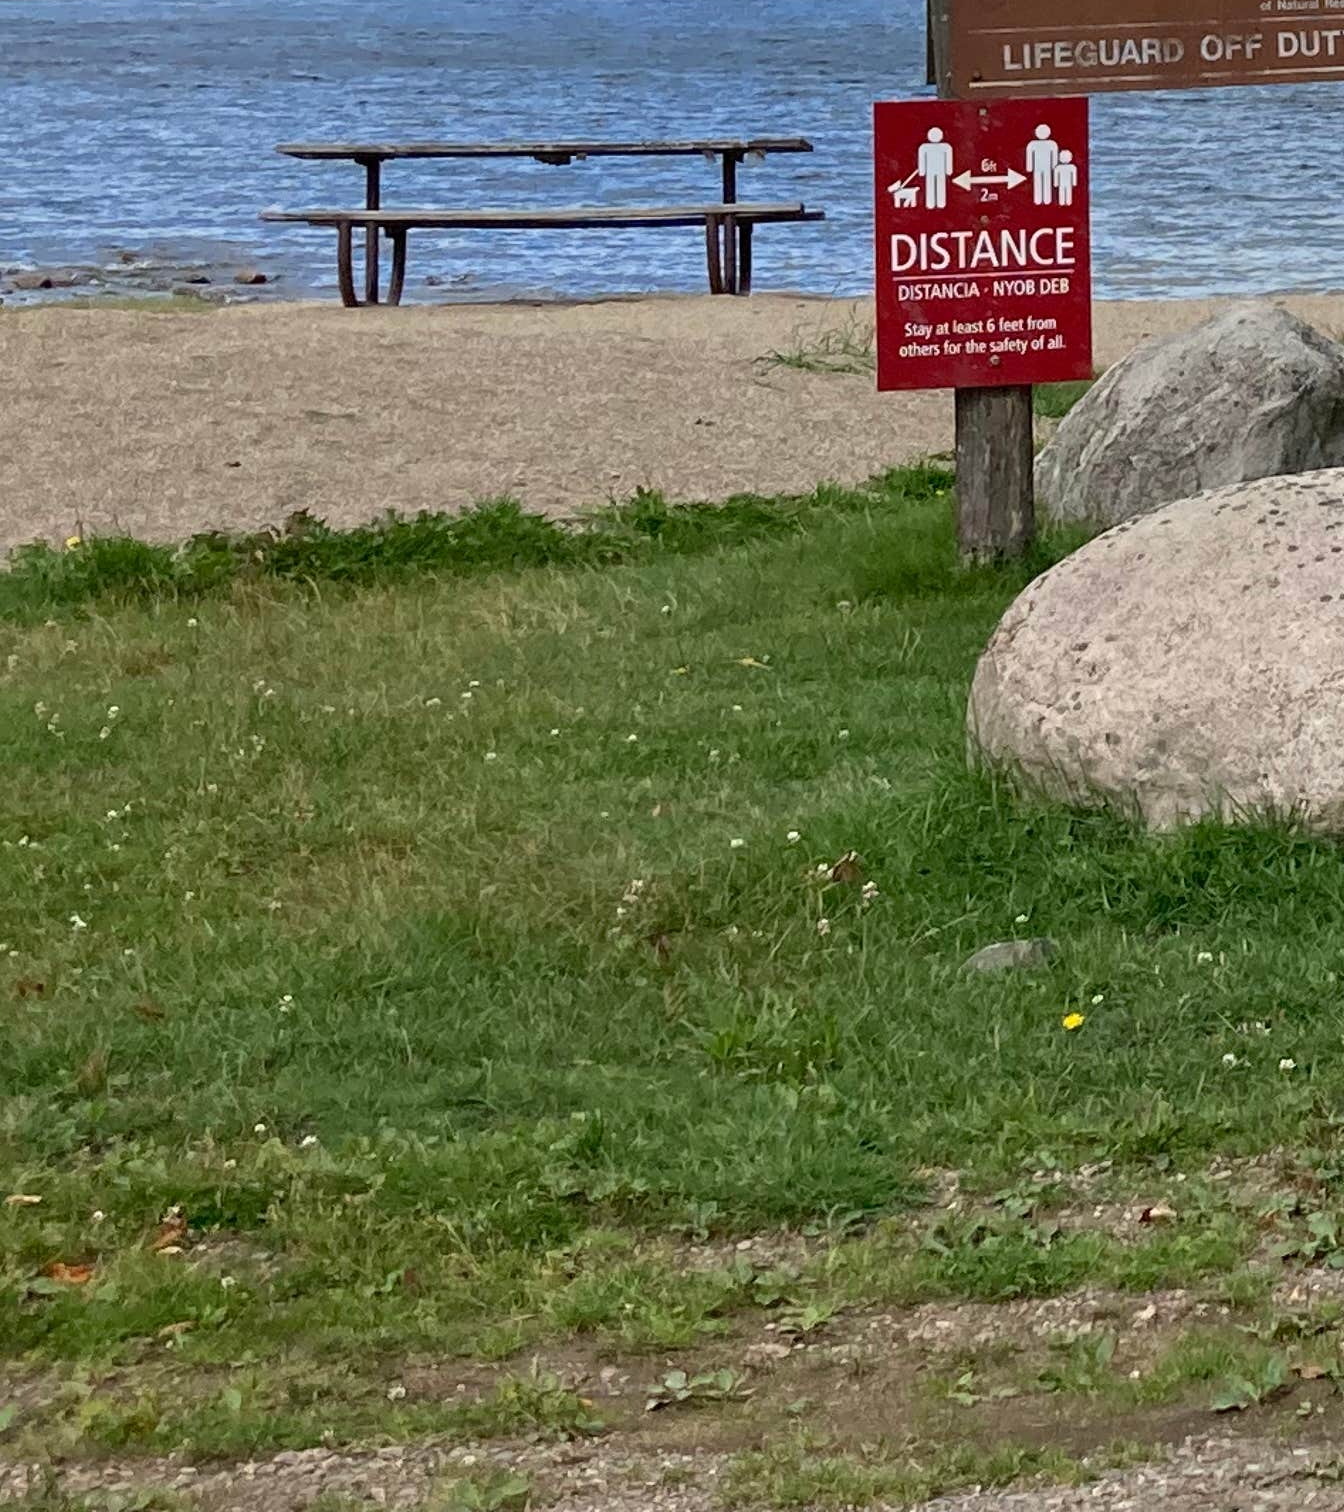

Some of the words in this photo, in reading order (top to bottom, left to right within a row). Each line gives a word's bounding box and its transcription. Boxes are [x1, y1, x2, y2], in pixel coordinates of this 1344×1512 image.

[1259, 0, 1272, 12] of
[1003, 38, 1184, 71] LIFEGUARD
[1200, 33, 1264, 62] OFF
[890, 226, 1076, 272] DISTANCE
[898, 282, 981, 302] DISTANCIA
[993, 279, 1036, 297] NYOB
[1040, 277, 1070, 295] DEB
[904, 322, 933, 340] Stay
[936, 321, 950, 335] at
[953, 319, 984, 334] least
[986, 317, 996, 333] 6
[999, 316, 1024, 332] feet
[1027, 315, 1057, 331] from
[899, 341, 941, 358] others
[944, 339, 962, 356] for
[965, 338, 987, 354] the
[989, 336, 1028, 355] safety
[1031, 334, 1045, 351] of
[1047, 333, 1067, 350] all.
